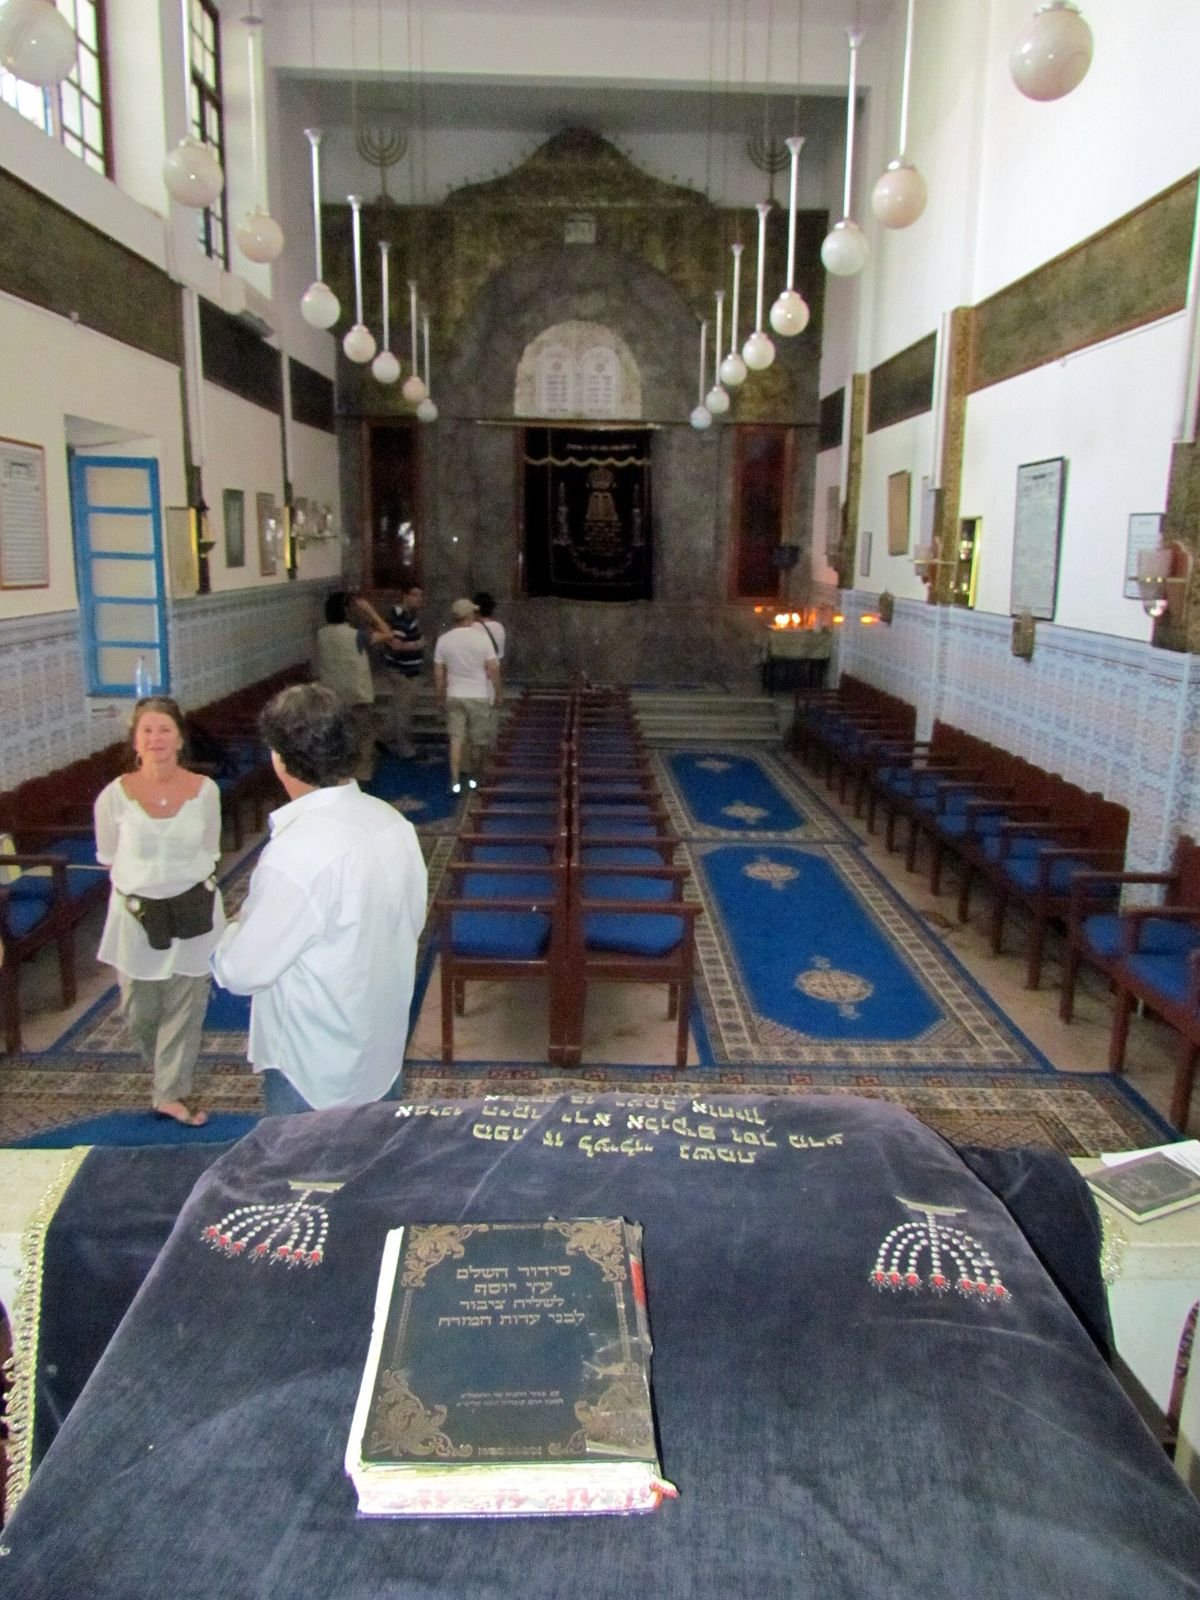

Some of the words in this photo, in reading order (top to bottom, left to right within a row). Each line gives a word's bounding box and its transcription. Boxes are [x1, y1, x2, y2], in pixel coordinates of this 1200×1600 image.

[561, 1112, 612, 1127] ירא
[627, 1114, 716, 1141] אלוקים
[789, 1133, 843, 1149] מרע
[473, 1124, 528, 1141] מפה
[542, 1130, 564, 1147] זו
[578, 1135, 654, 1158] לעילוי
[679, 1143, 757, 1164] נשמת
[456, 1265, 509, 1279] השלם
[517, 1265, 571, 1277] סידור
[474, 1282, 517, 1296] יוסף
[526, 1281, 553, 1294] עץ
[460, 1299, 506, 1311] ציבור
[513, 1295, 565, 1309] לשליח
[438, 1315, 492, 1328] המזרח
[499, 1313, 541, 1326] עדות
[548, 1309, 586, 1326] לבני
